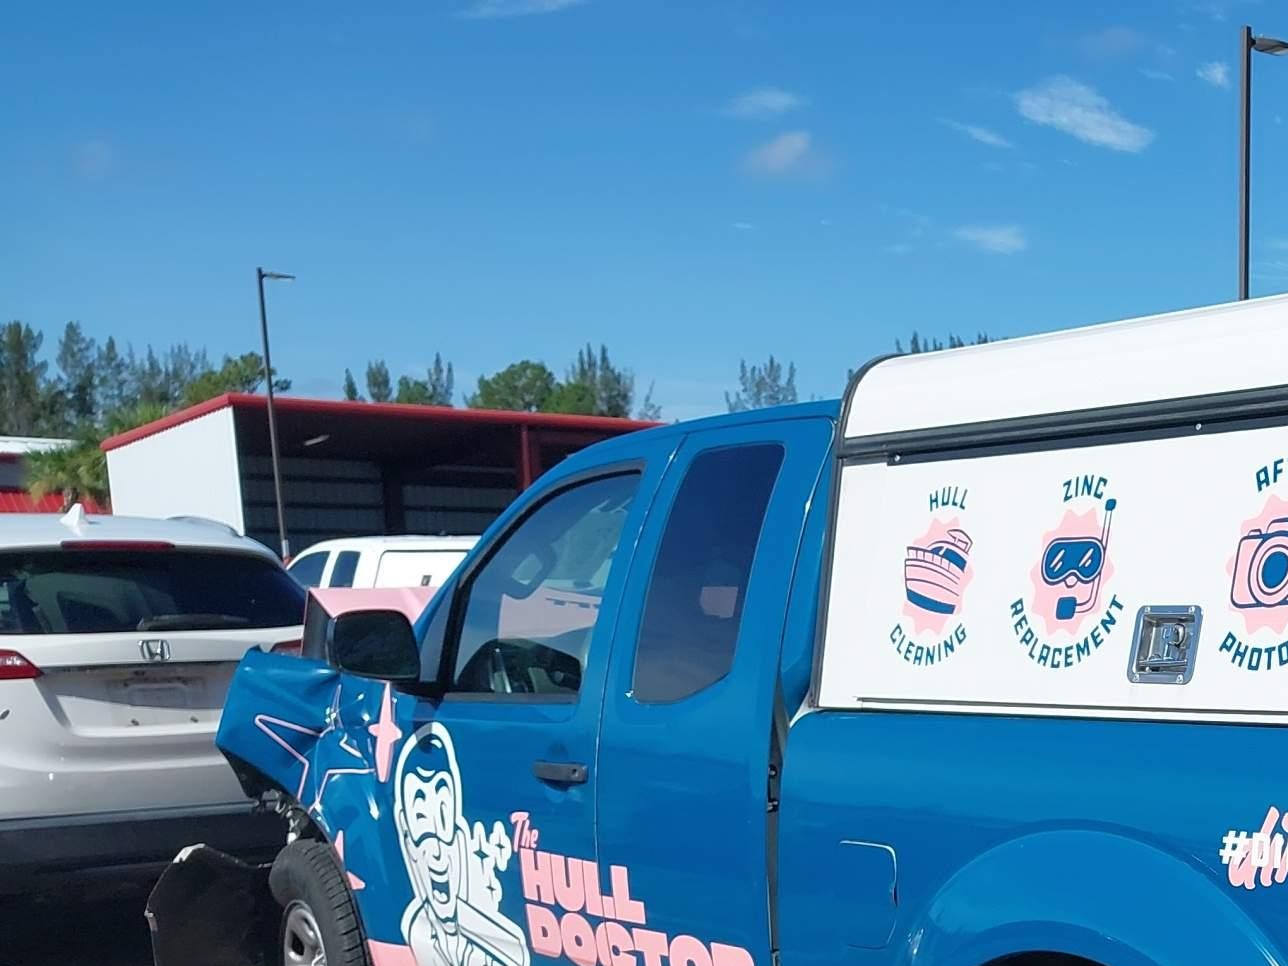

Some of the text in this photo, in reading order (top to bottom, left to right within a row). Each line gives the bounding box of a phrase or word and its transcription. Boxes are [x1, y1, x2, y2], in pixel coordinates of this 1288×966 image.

[929, 486, 968, 512] HULL
[1063, 474, 1108, 502] ZINC
[889, 623, 967, 666] CLEANING
[1010, 594, 1124, 669] REPLACEMENT
[509, 811, 539, 853] The
[519, 848, 647, 925] HULL
